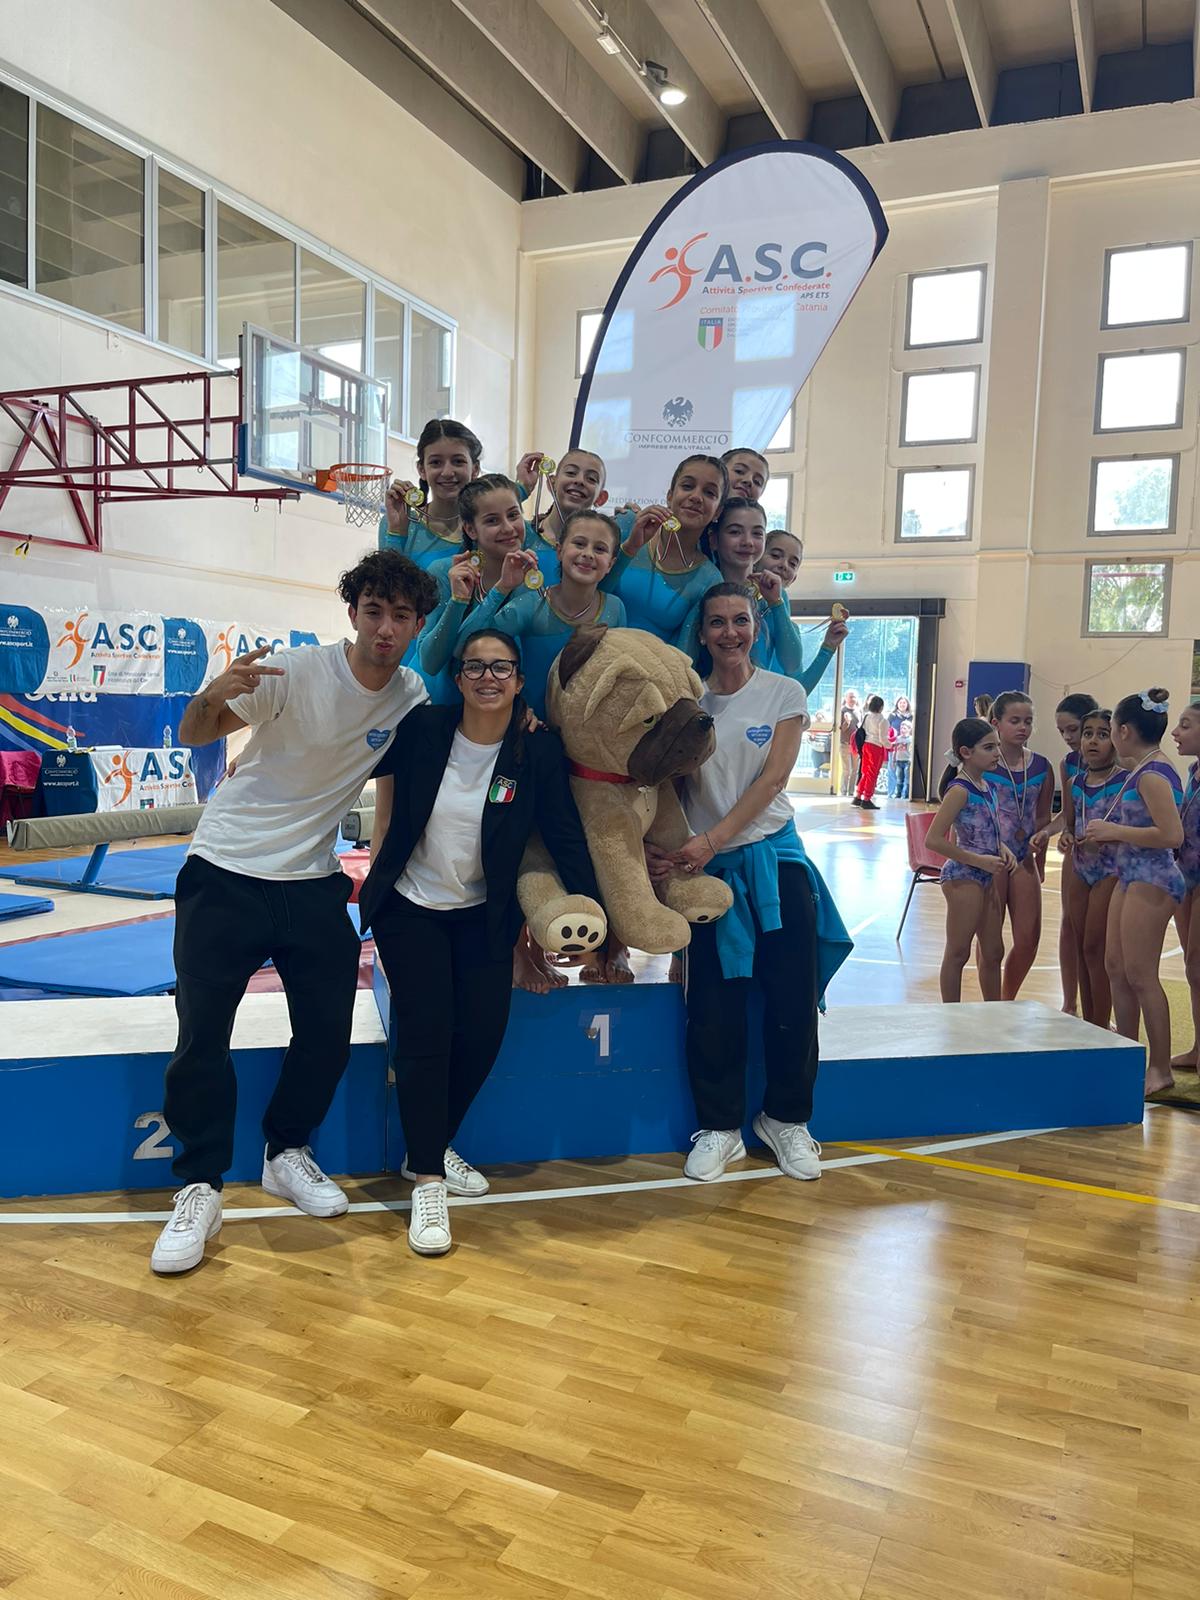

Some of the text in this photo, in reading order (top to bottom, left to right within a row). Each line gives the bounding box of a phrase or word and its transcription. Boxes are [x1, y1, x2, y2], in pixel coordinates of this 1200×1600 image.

[704, 241, 832, 283] A.S.C.
[737, 284, 773, 295] Sportive
[775, 281, 831, 292] Confederate
[815, 291, 830, 299] ETS
[701, 318, 723, 326] ITALIA
[91, 622, 161, 651] A.S.C.
[588, 1014, 609, 1057] 1
[133, 1111, 174, 1160] 2
